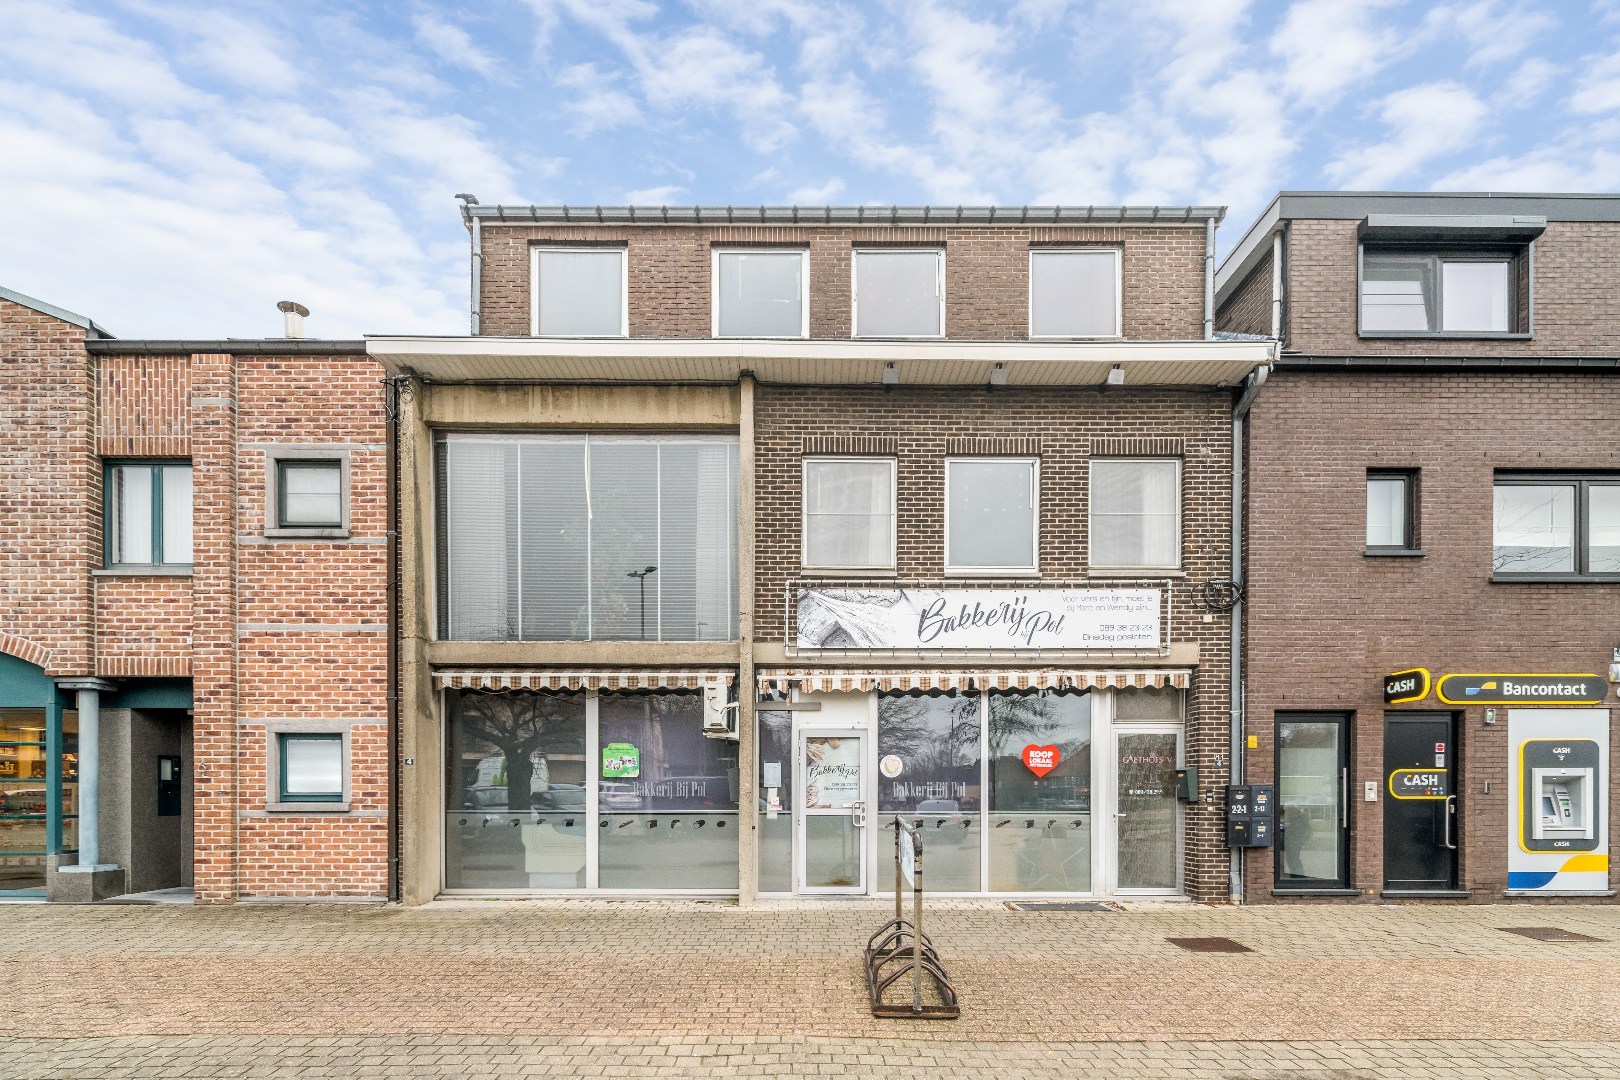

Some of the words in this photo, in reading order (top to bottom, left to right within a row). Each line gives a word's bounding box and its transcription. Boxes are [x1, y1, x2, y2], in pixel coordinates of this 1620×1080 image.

[917, 596, 1031, 643] Bakkerij
[1025, 610, 1065, 646] Pol
[1099, 624, 1115, 632] 089
[1116, 624, 1128, 632] 38
[1129, 624, 1140, 632] 23
[1141, 624, 1153, 632] 23
[1082, 633, 1115, 642] Dinsdag
[1116, 633, 1153, 642] gesloten
[1386, 679, 1415, 694] CASH
[1503, 681, 1587, 696] Bancontact
[1029, 750, 1054, 759] KOOP
[1403, 774, 1438, 786] CASH
[633, 781, 673, 799] Bakkerij
[676, 781, 689, 799] Bij
[691, 781, 706, 797] Pol
[893, 781, 933, 799] Bakkerij
[936, 781, 948, 799] Bij
[951, 781, 966, 797] Pol
